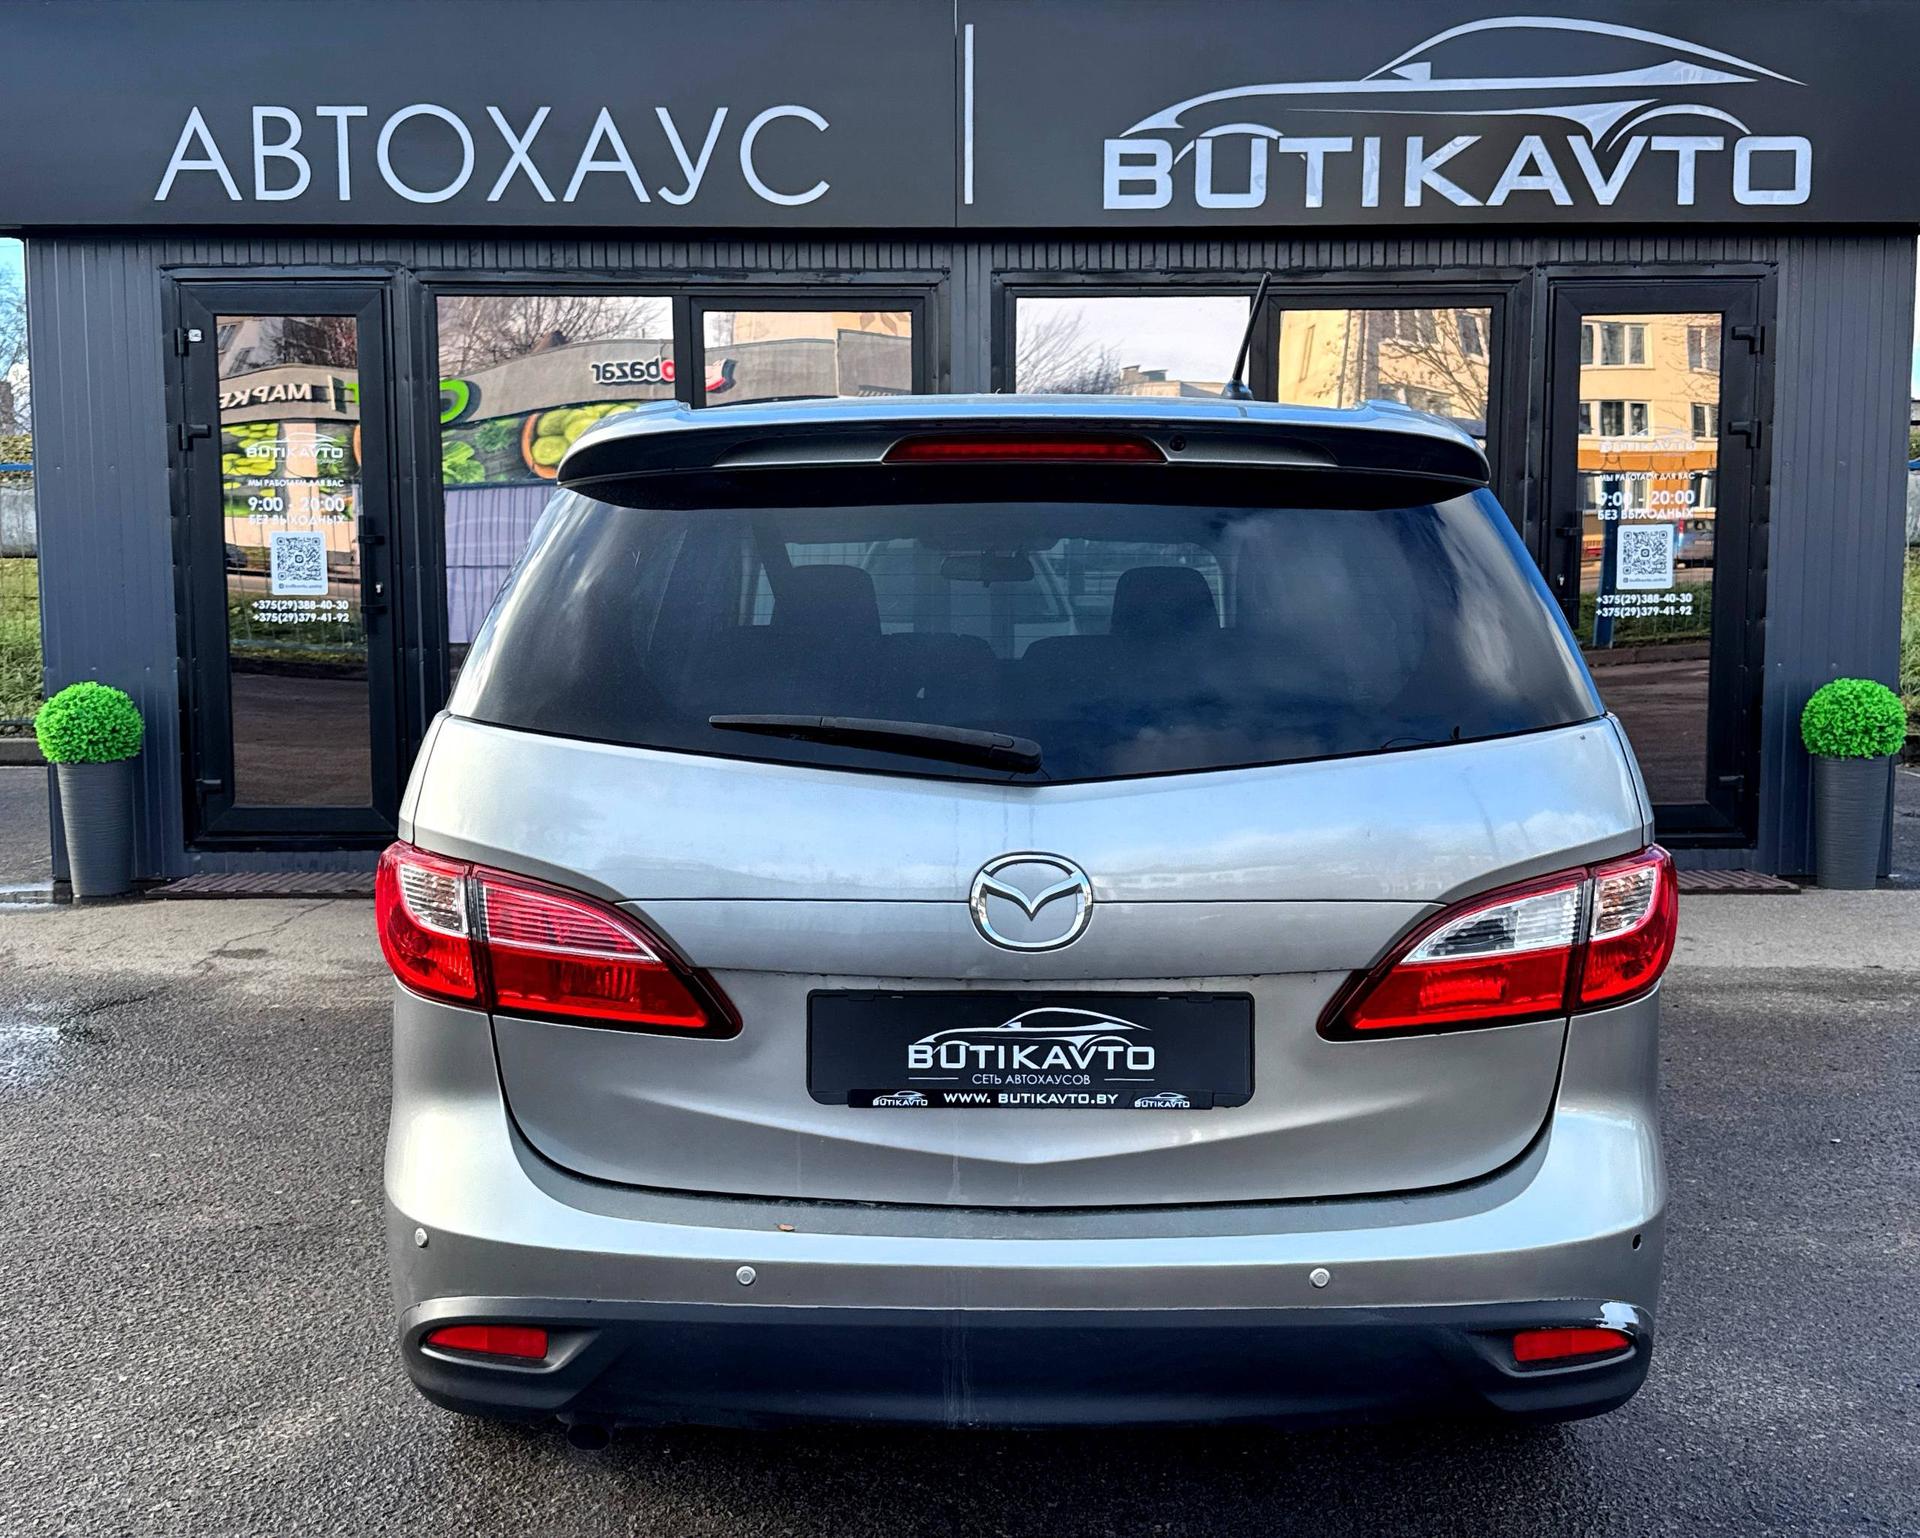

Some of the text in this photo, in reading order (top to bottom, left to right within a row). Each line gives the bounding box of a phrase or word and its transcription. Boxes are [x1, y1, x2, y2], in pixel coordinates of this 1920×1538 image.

[154, 104, 831, 206] АВТОХАУС
[1102, 135, 1812, 209] BUTIKAVTO
[246, 446, 344, 458] BUTIKAVTO
[326, 479, 344, 487] ВАС
[248, 496, 284, 512] 9:00
[302, 496, 345, 512] 20:00
[1599, 491, 1633, 506] 9:00
[1650, 490, 1696, 505] 20:00
[1598, 508, 1694, 520] БЕЗ ВЫХОДНЫХ
[908, 1044, 1155, 1070] BUTIKAVTO
[972, 1073, 1091, 1085] СЕТЬ АВТОХАУСОВ
[872, 1098, 928, 1107] BUTIKAVTO
[998, 1092, 1119, 1104] BUTIKAVTO.BY
[1134, 1099, 1190, 1108] BUTIKAVTO
